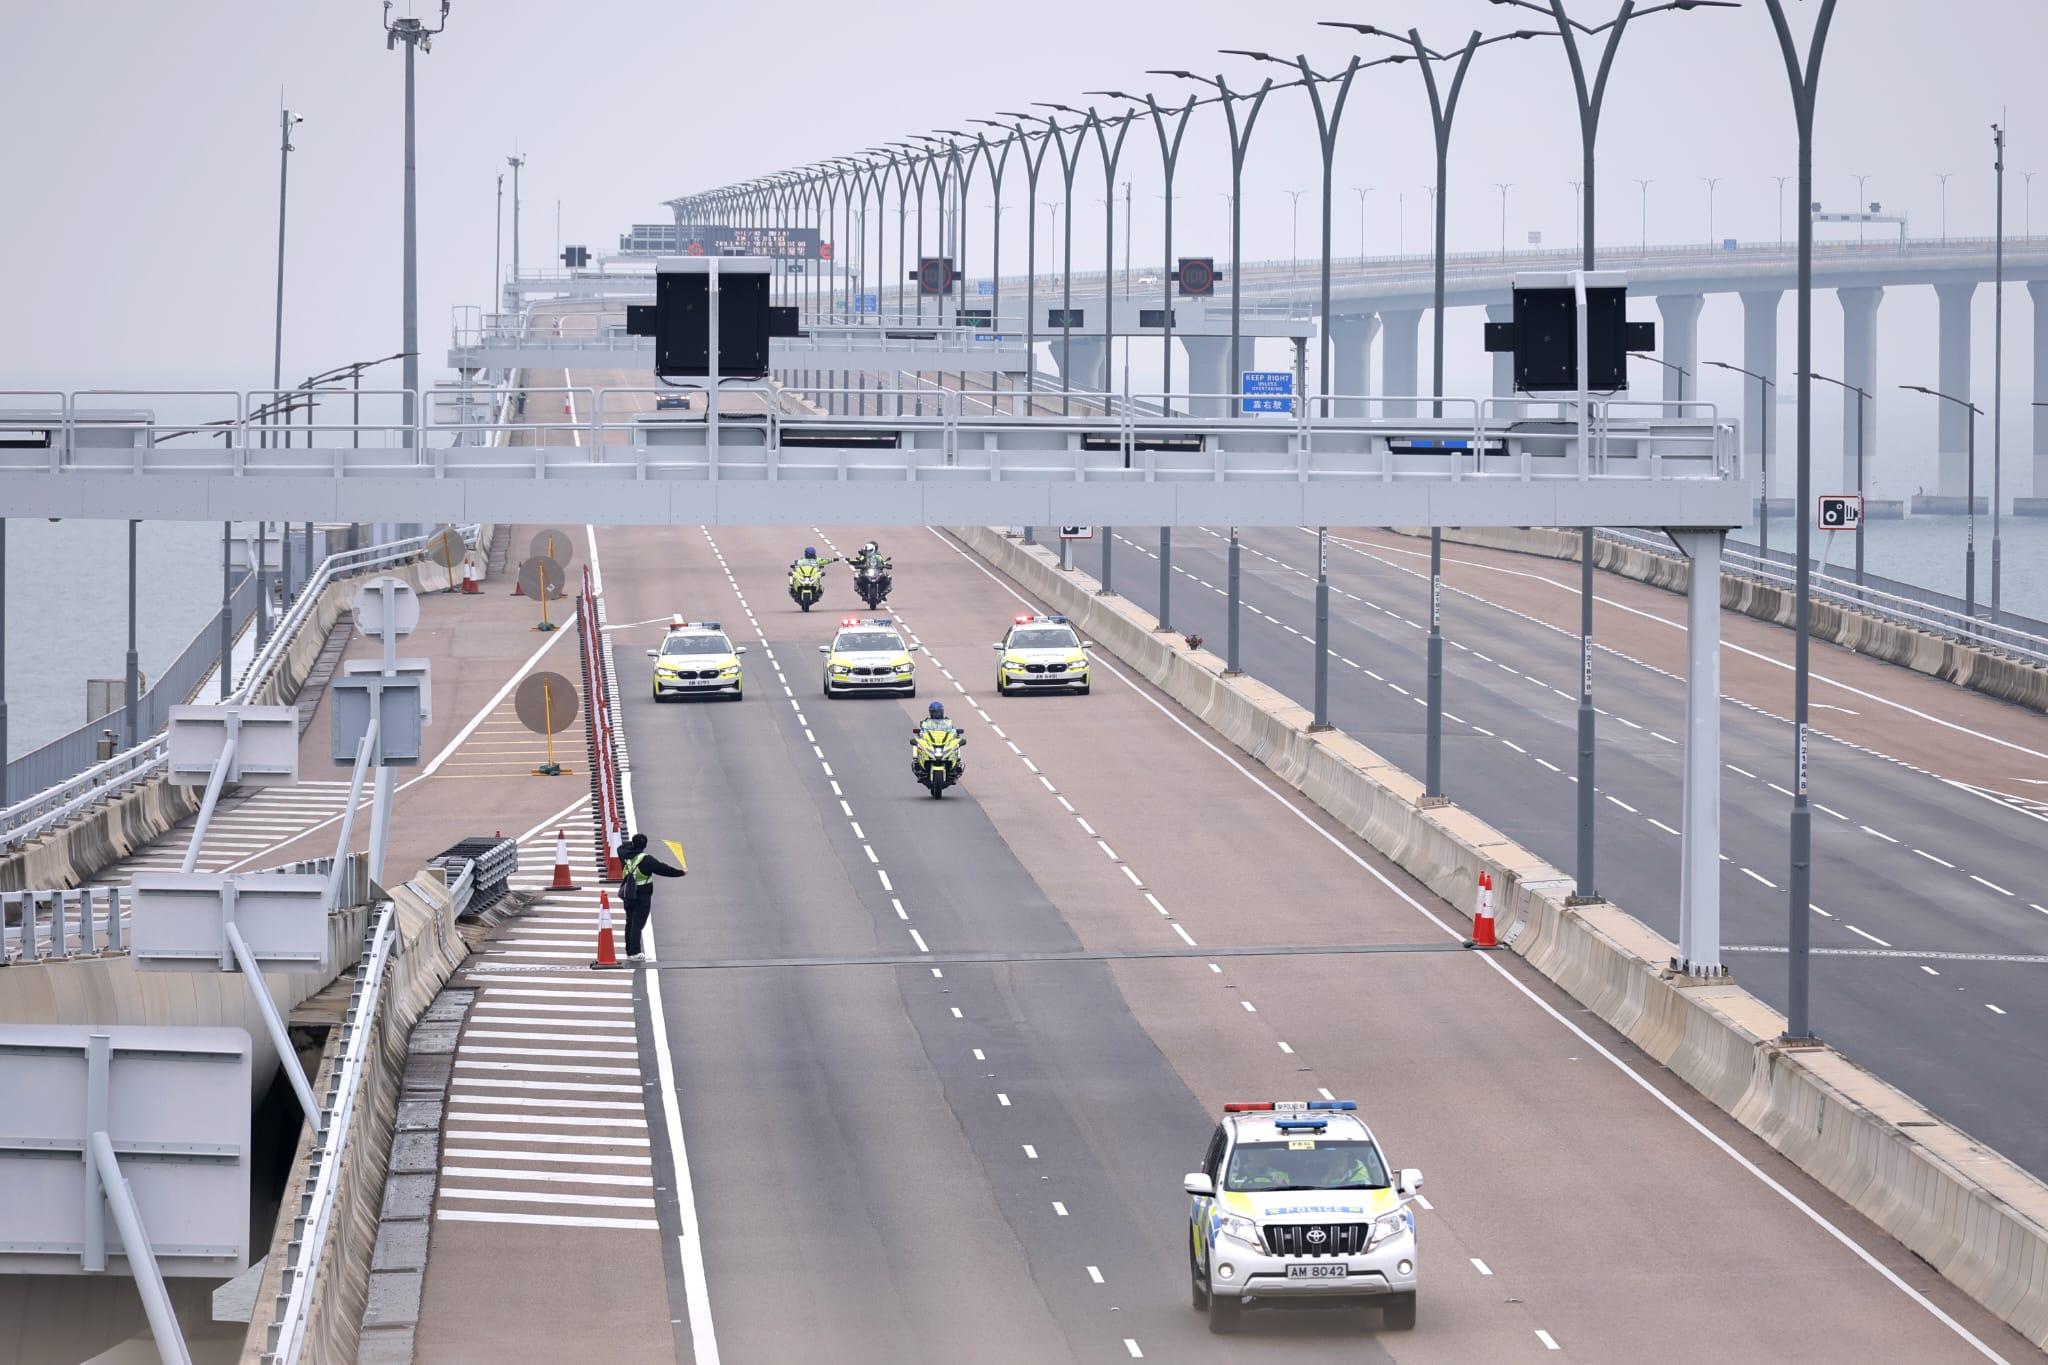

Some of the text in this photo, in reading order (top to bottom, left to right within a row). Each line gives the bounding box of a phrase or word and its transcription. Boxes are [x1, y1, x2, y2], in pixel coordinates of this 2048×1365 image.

[1801, 727, 1807, 742] GC
[1291, 1266, 1344, 1277] AM 8042
